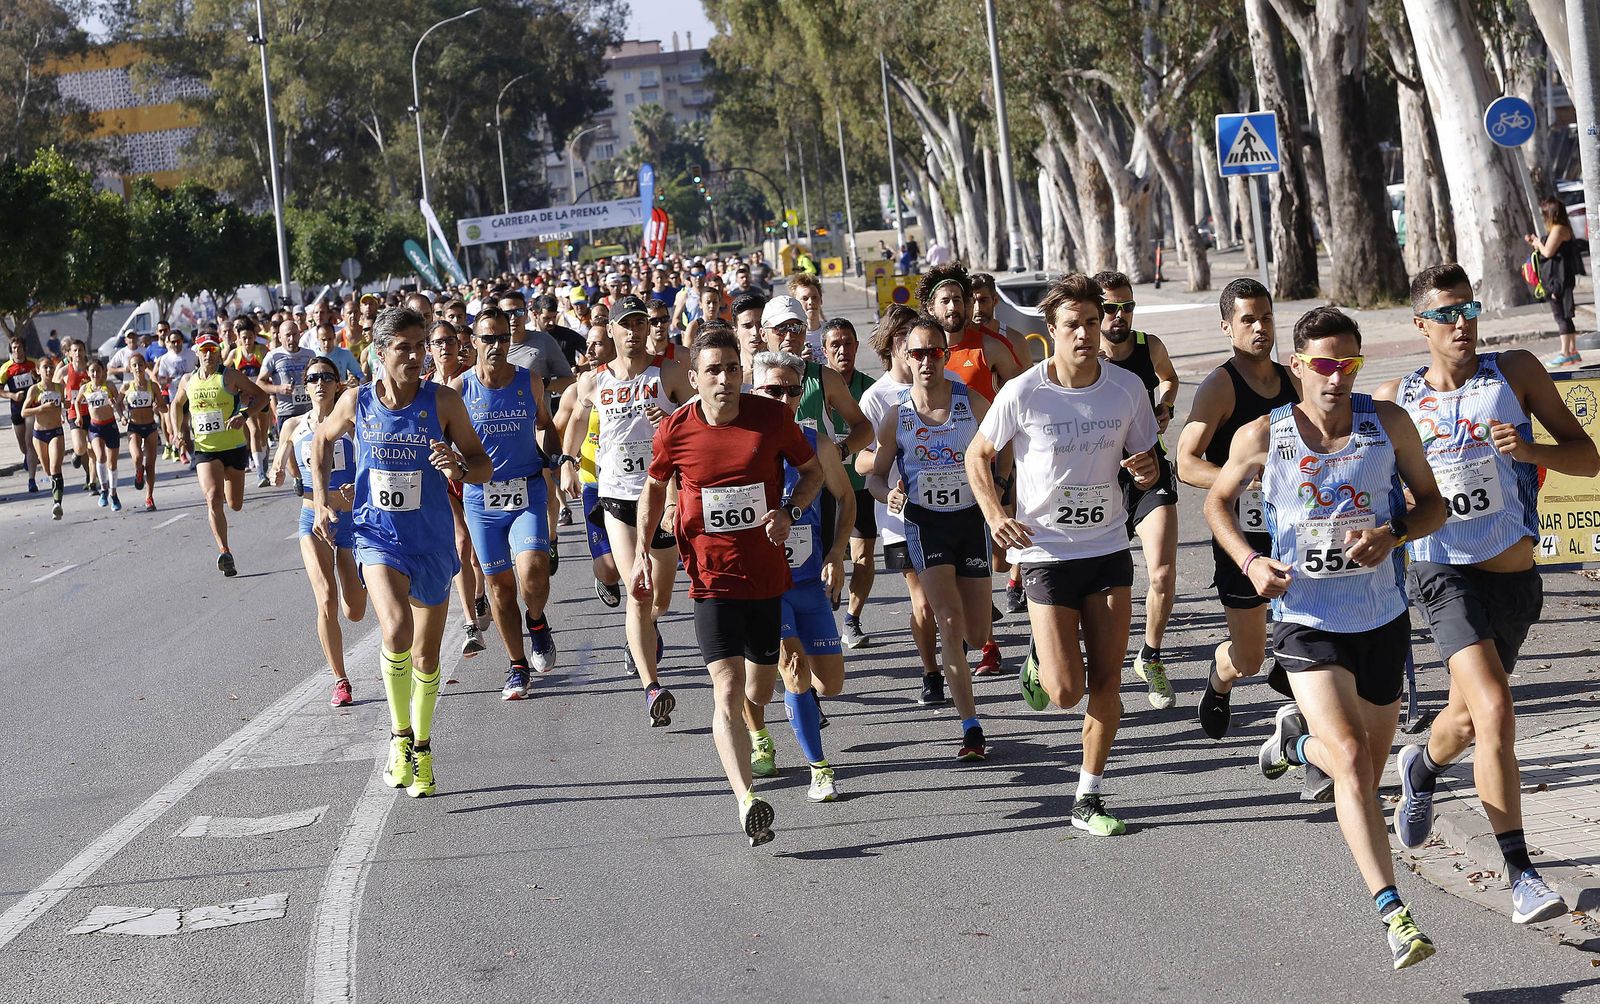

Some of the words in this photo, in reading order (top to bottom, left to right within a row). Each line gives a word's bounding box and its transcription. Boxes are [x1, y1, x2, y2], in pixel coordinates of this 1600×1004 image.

[491, 215, 538, 229] CARRERA
[540, 211, 553, 222] DE
[555, 210, 568, 221] LA
[570, 205, 609, 218] PRENSA
[541, 232, 571, 241] SALIDA
[194, 391, 217, 400] DAVID
[198, 421, 220, 432] 283
[1090, 434, 1115, 456] Asia
[623, 457, 645, 472] 31
[380, 490, 404, 508] 80
[489, 493, 523, 507] 276
[923, 488, 960, 505] 151
[1298, 482, 1370, 512] 2020
[710, 507, 755, 527] 560
[1056, 506, 1104, 524] 256
[1570, 538, 1584, 554] AL
[966, 558, 987, 568] 2020
